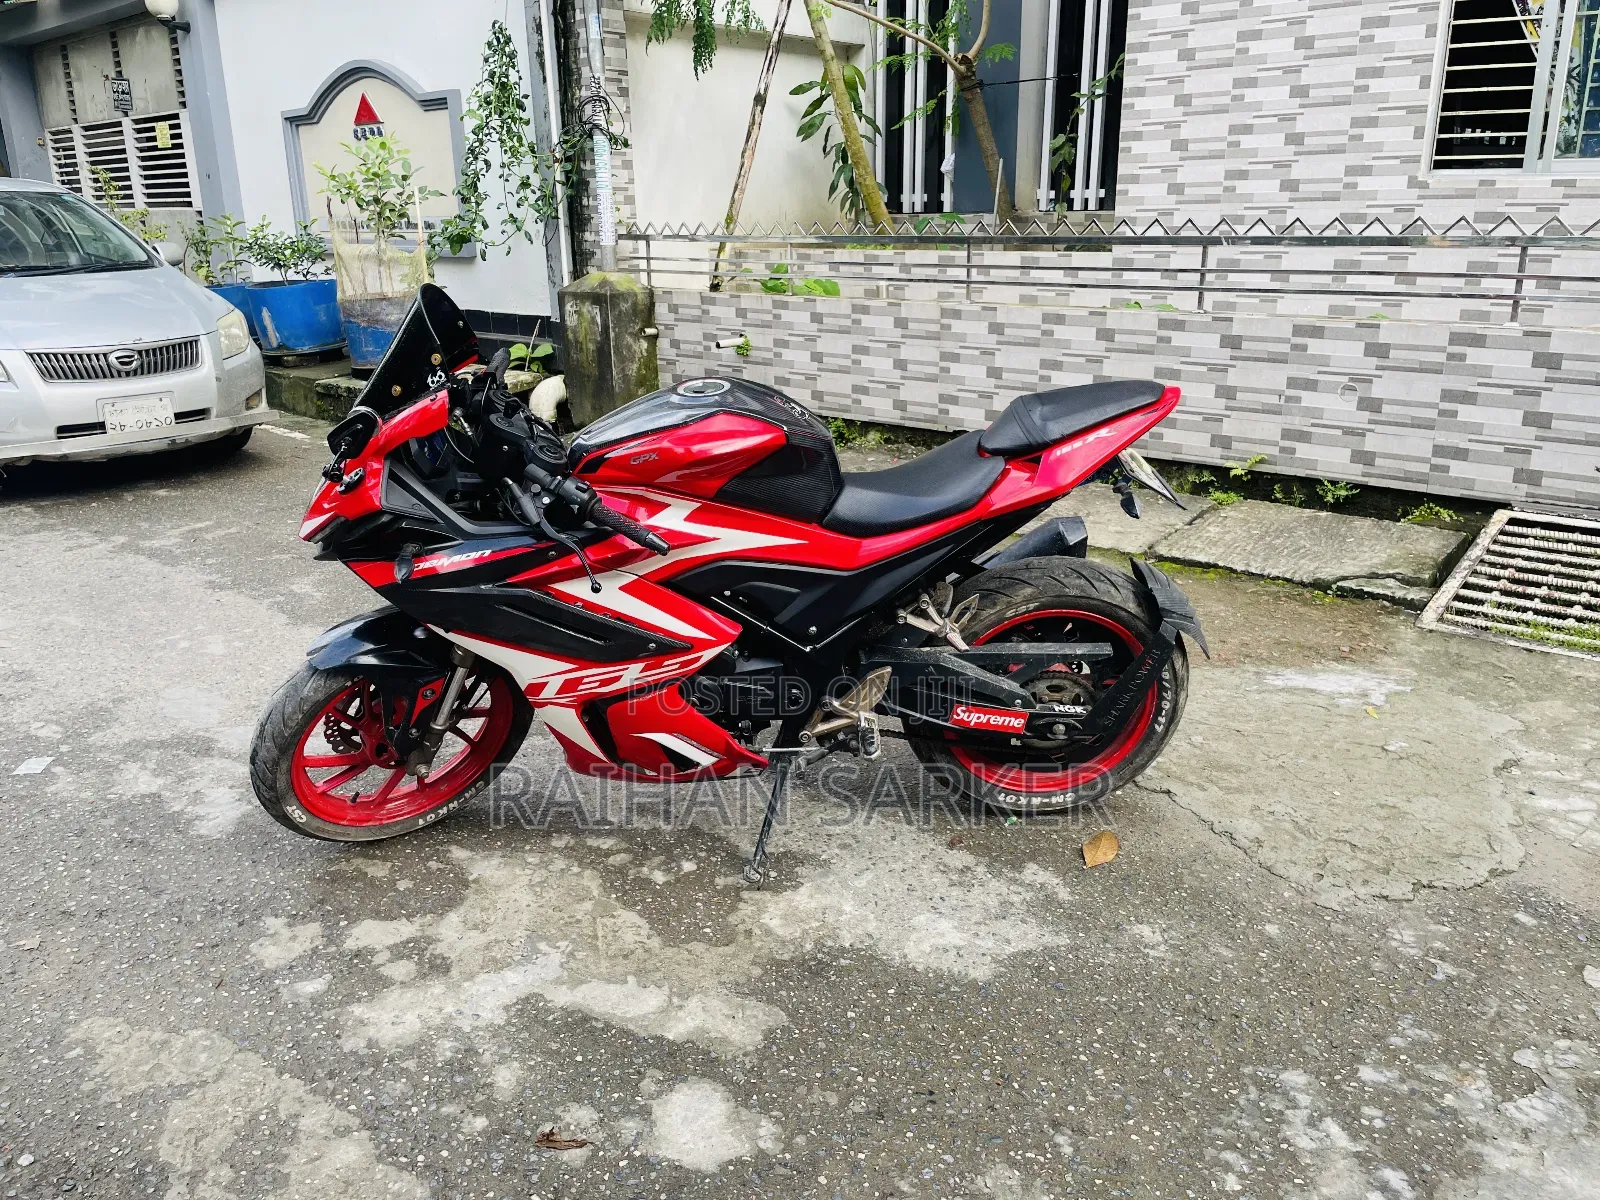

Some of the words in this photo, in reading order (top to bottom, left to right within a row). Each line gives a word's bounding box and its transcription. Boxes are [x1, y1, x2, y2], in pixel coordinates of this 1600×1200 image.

[630, 451, 659, 465] GPX
[1103, 692, 1134, 727] SHARK
[1128, 649, 1161, 690] POWER
[953, 706, 1025, 728] Supreme
[1053, 704, 1087, 714] NGK
[418, 780, 486, 826] CM-NK01
[286, 804, 307, 823] CST
